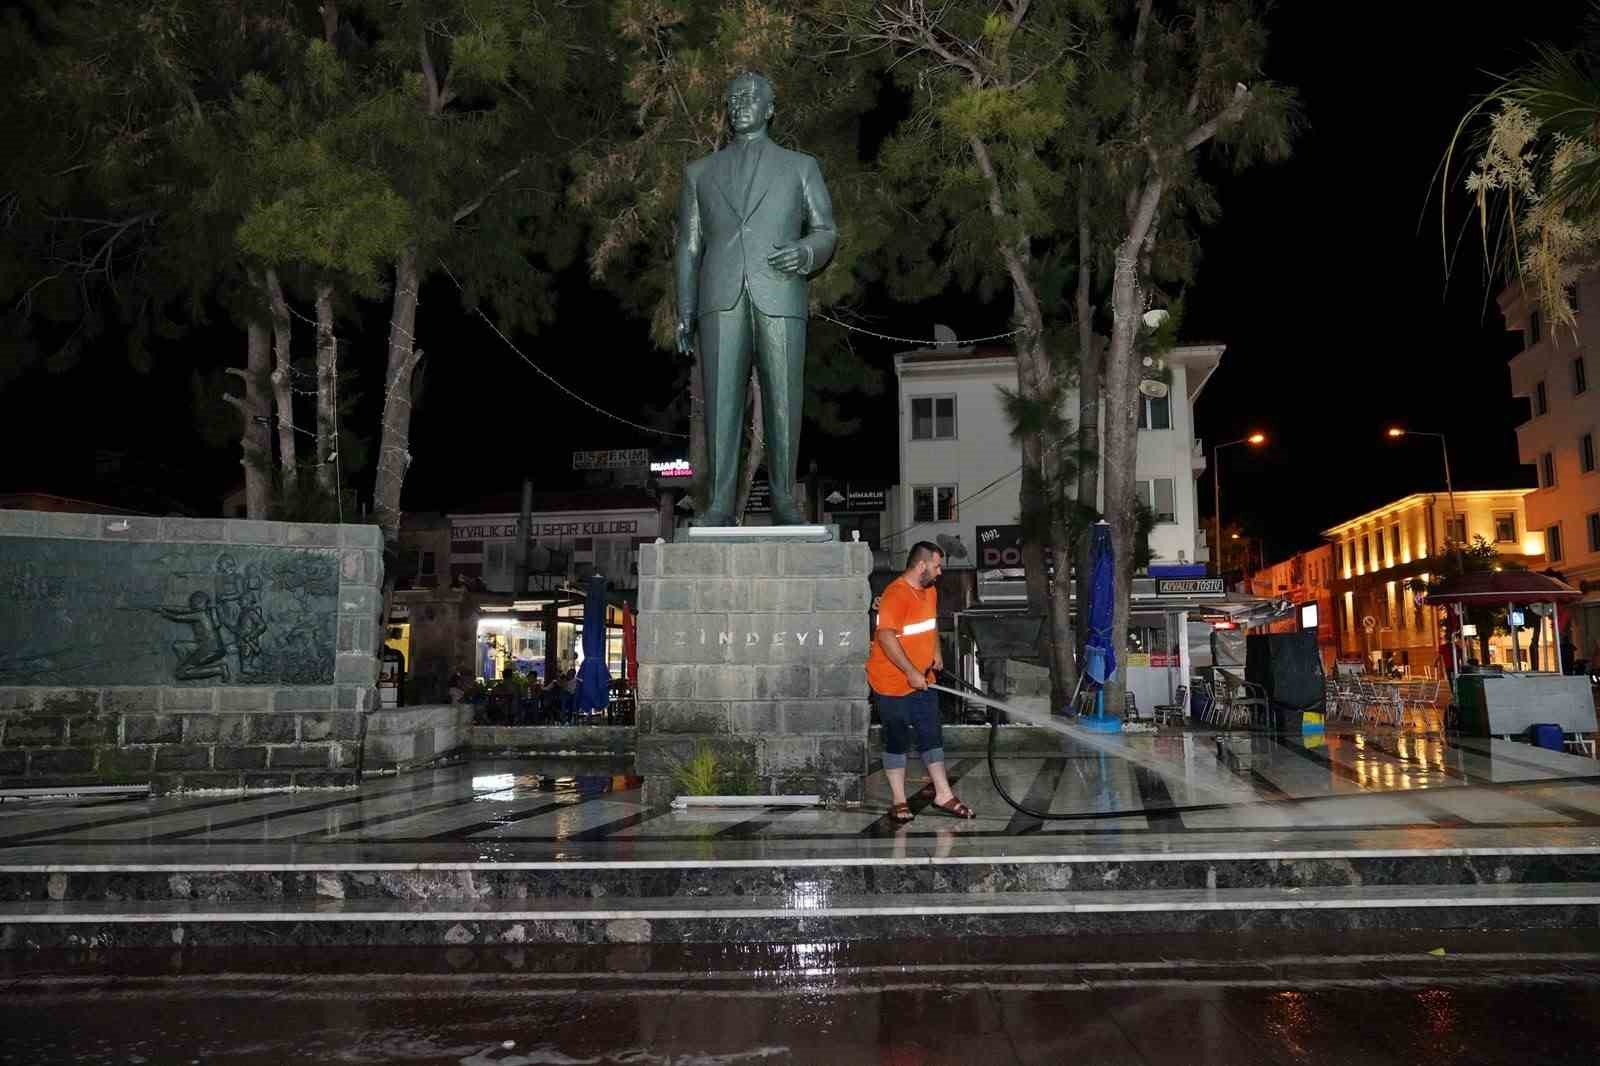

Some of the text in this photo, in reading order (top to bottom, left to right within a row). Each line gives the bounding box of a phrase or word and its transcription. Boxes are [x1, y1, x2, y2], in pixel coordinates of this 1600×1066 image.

[651, 459, 689, 471] KUAFÖR
[451, 526, 498, 538] AYVALIK
[543, 522, 578, 536] SPOR
